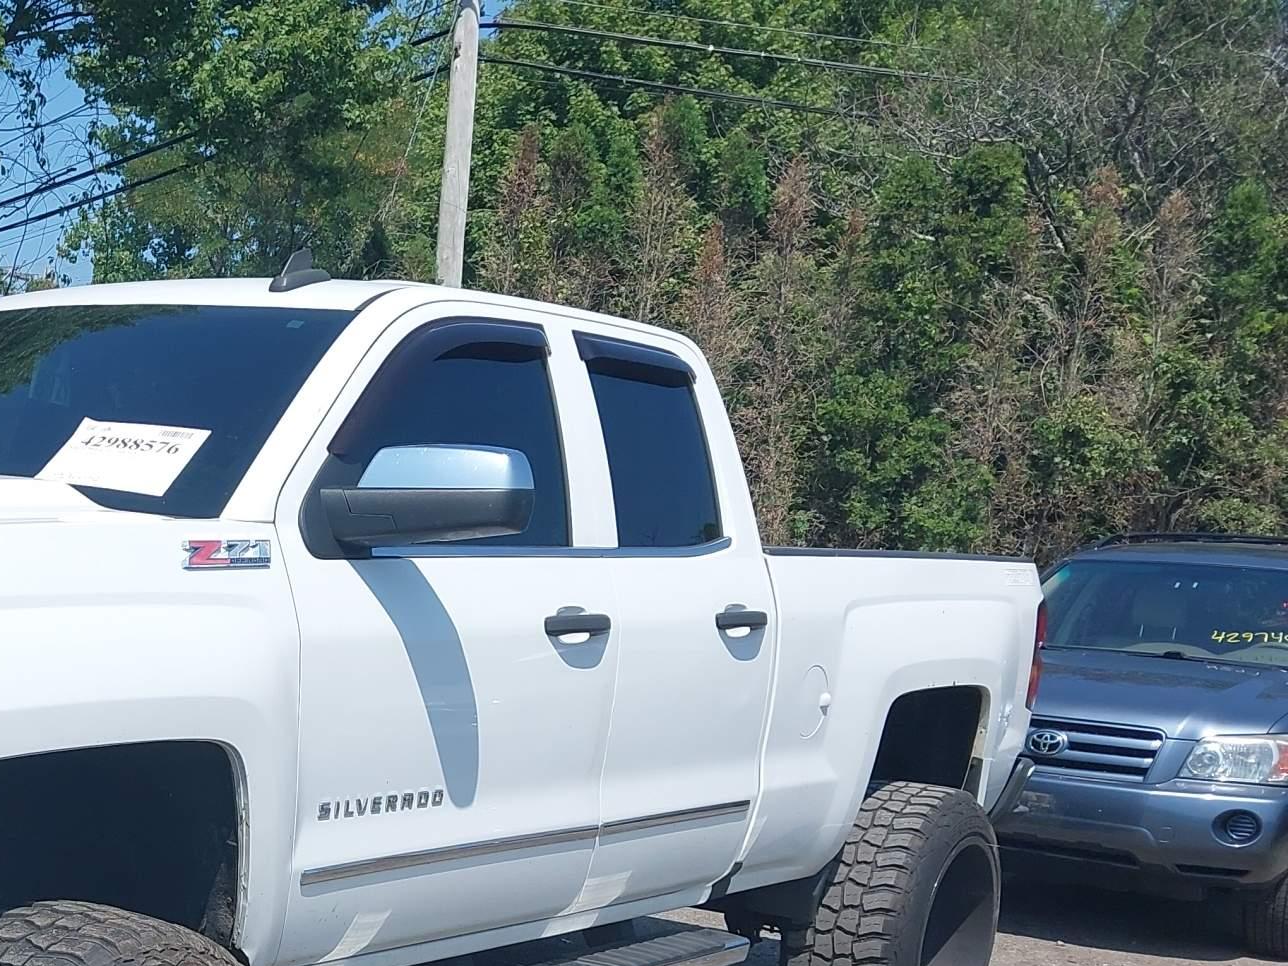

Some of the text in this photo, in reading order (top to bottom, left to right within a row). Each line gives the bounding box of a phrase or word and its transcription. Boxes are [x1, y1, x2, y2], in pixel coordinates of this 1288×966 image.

[81, 435, 183, 455] 42988576
[187, 540, 271, 566] Z71
[317, 789, 444, 821] SILVERADO
